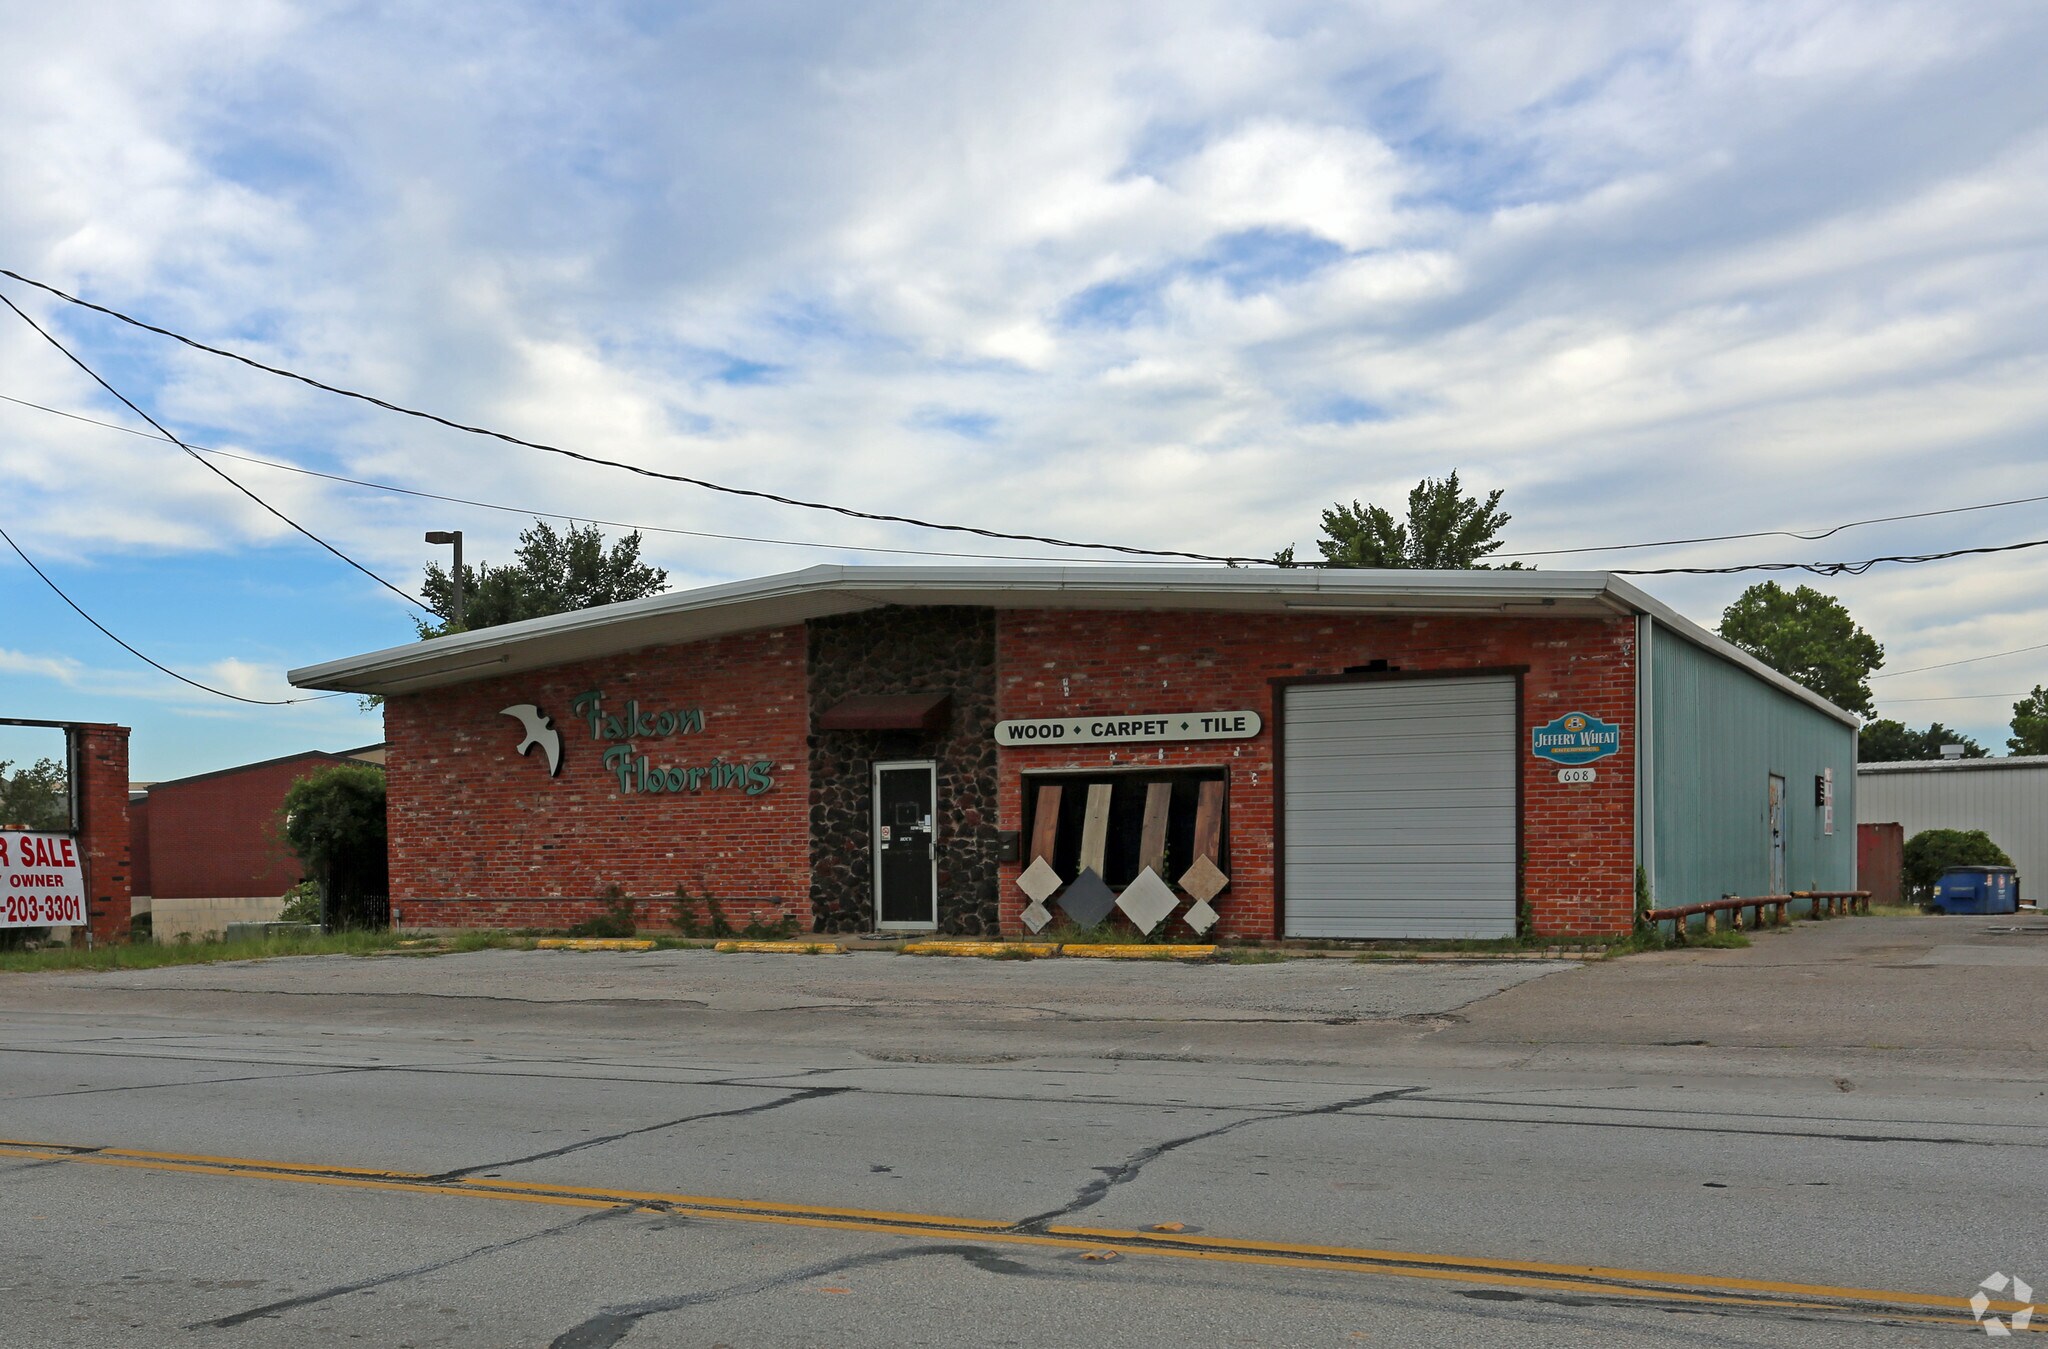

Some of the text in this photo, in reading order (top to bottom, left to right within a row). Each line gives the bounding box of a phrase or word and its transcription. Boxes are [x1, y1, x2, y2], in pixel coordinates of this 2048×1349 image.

[572, 690, 706, 740] Falcon
[1008, 716, 1246, 740] WOOD CARPET TILE
[1535, 729, 1616, 748] JEFFERY WHEAT
[602, 744, 775, 796] Flooring
[1564, 770, 1589, 782] 608
[20, 835, 76, 868] SALE
[9, 874, 64, 888] OWNER
[0, 894, 81, 922] -203-3301
